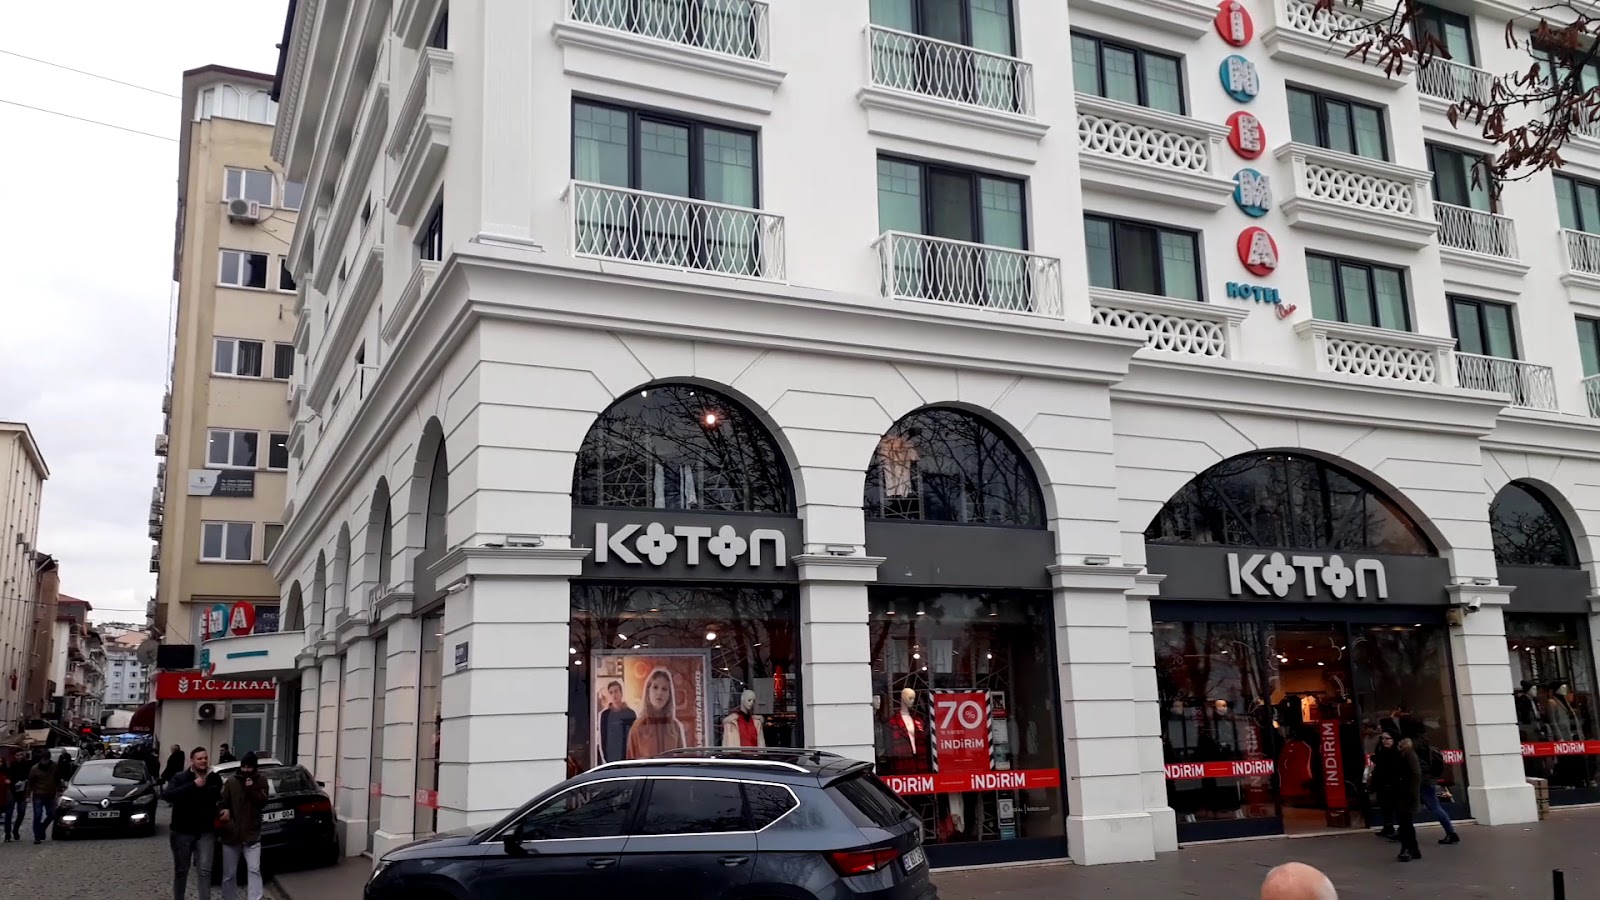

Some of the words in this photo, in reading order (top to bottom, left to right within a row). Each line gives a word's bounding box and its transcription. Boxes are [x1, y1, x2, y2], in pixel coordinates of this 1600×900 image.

[1226, 281, 1282, 304] HOTEL
[595, 521, 787, 568] KOTON
[1226, 551, 1389, 599] KOTON
